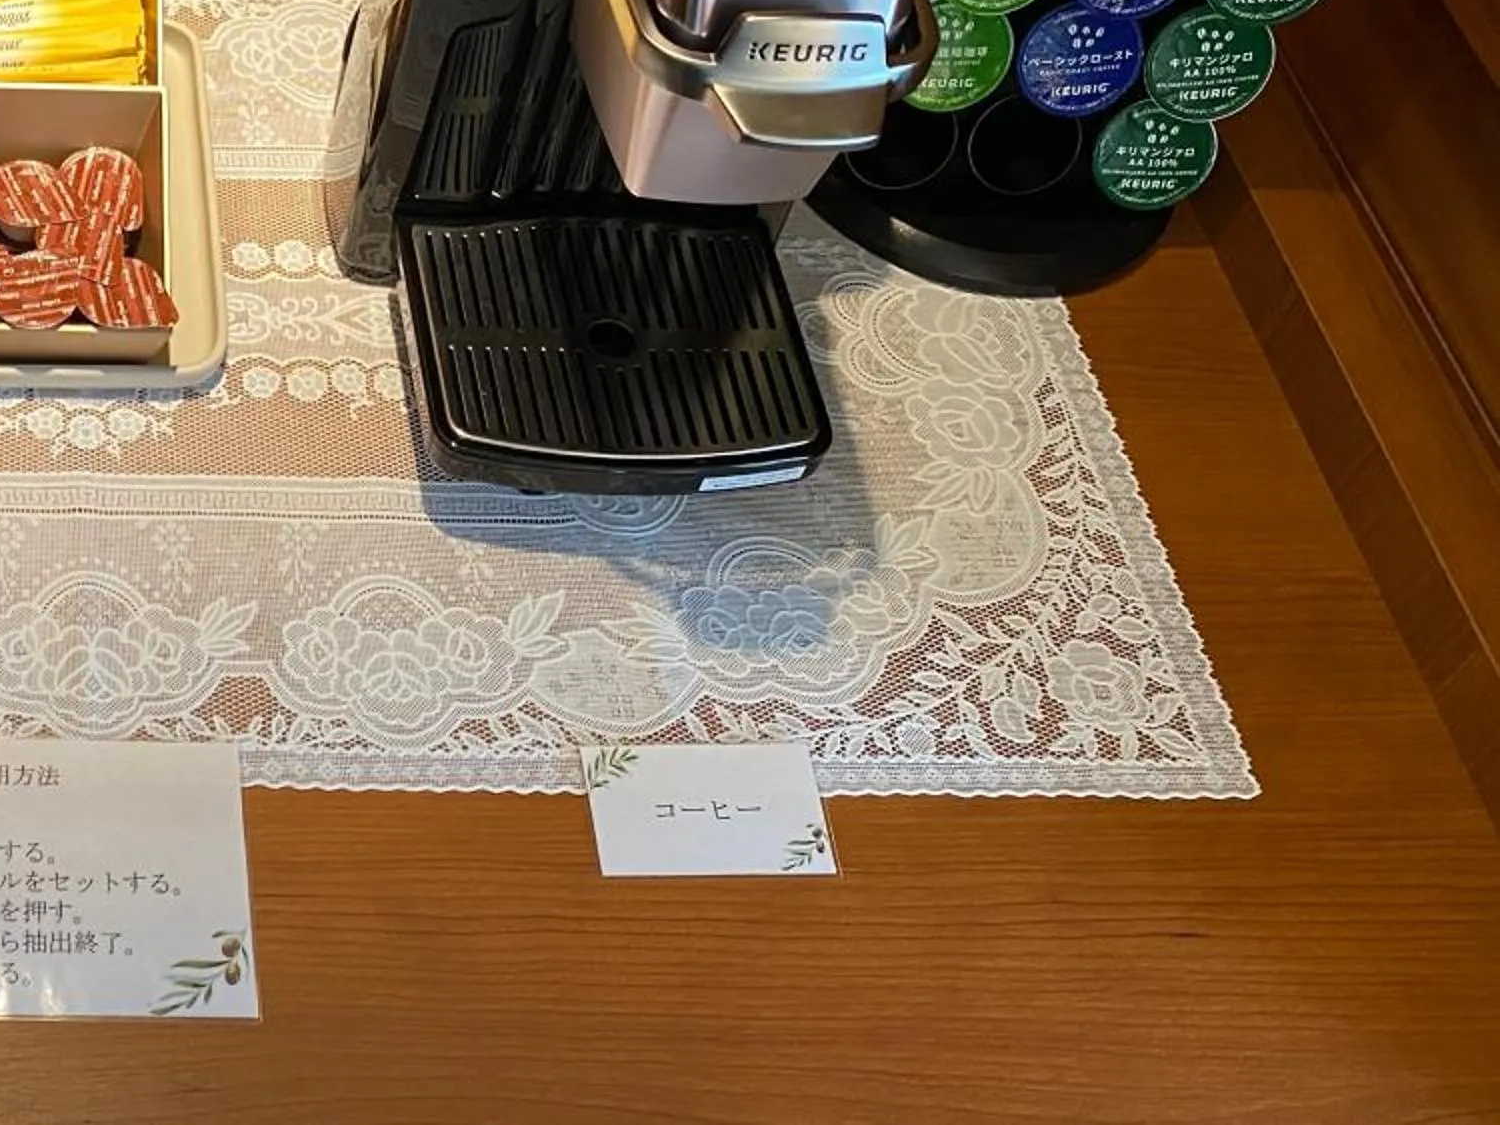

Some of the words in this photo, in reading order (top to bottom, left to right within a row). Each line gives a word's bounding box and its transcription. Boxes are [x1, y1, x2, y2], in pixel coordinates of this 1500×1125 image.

[749, 42, 869, 62] KEURIG
[1026, 49, 1133, 67] ベーシックロースト
[1183, 68, 1200, 78] AA
[1051, 82, 1112, 97] KEURIG
[1179, 86, 1240, 101] KEURIG
[1127, 158, 1144, 167] AA
[1120, 178, 1179, 190] KEURIG
[655, 801, 762, 820] コーヒー
